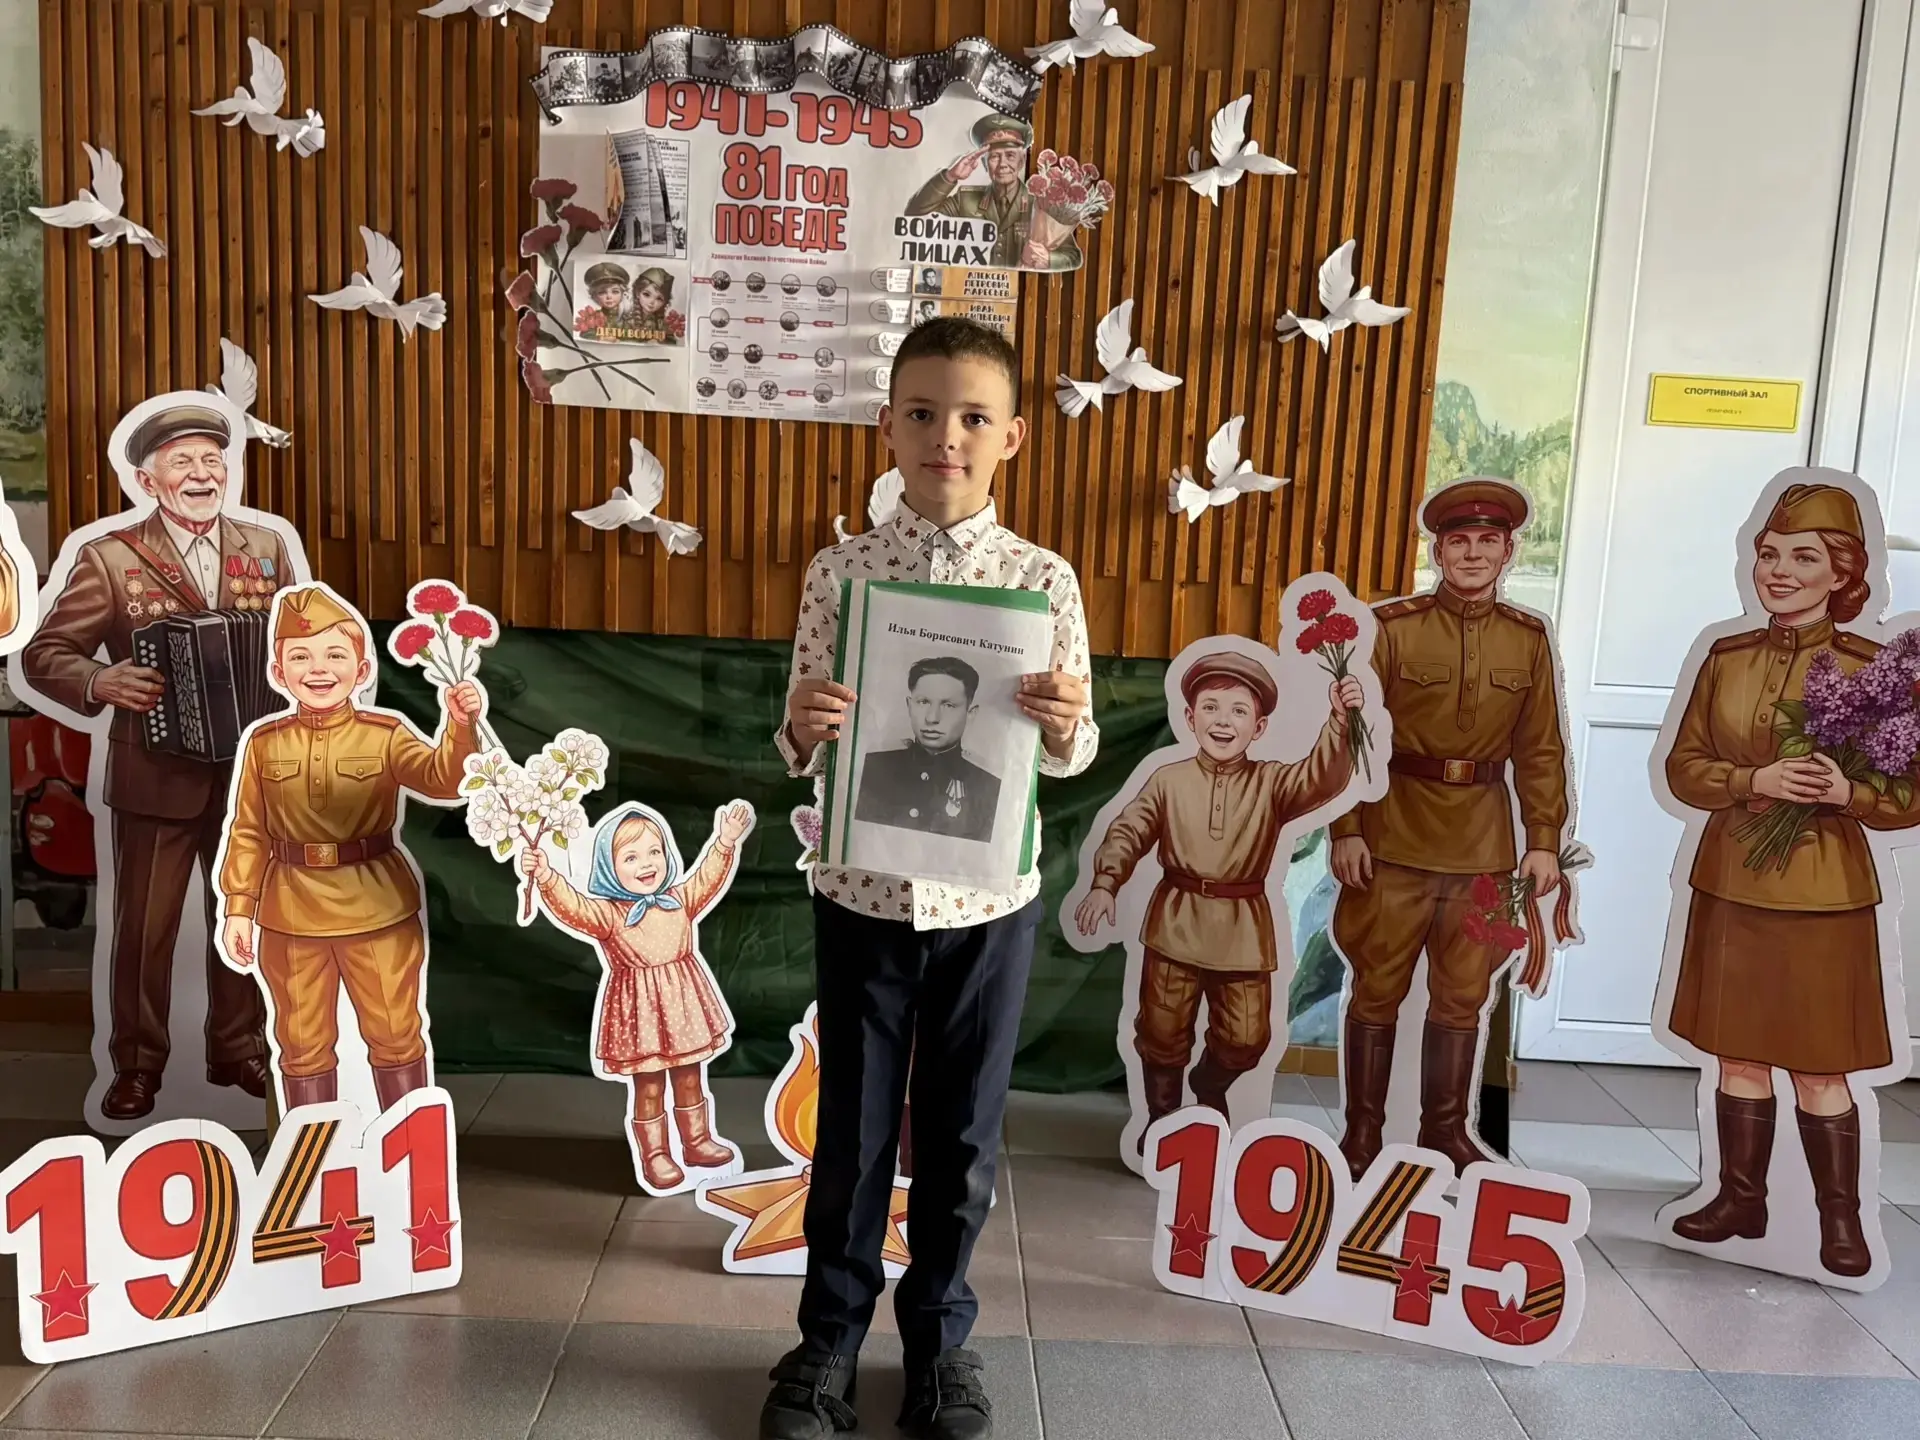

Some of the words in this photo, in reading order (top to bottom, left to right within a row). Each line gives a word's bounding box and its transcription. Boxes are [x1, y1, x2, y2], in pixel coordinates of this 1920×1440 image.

[645, 79, 923, 148] 1941-1945
[722, 142, 781, 200] 81
[715, 203, 847, 252] ПОБЕДЕ
[894, 213, 975, 242] ВОЙНА
[982, 223, 997, 242] В
[900, 241, 989, 265] ЛИЦАХ
[964, 280, 1010, 289] ПЕТРОВИЧ
[967, 271, 1008, 281] АЛЕКСЕЙ
[963, 288, 1010, 298] МАРЕСЬЕВ
[970, 304, 994, 313] ИВАН
[596, 327, 625, 338] ДЕТИ
[1684, 387, 1748, 398] СПОРТИВНЫЙ
[1750, 391, 1768, 399] ЗАЛ
[888, 622, 916, 636] Илья
[919, 628, 976, 647] Борисович
[979, 639, 1024, 655] Катунин
[6, 1103, 458, 1343] 1941
[1156, 1121, 1571, 1346] 1945
